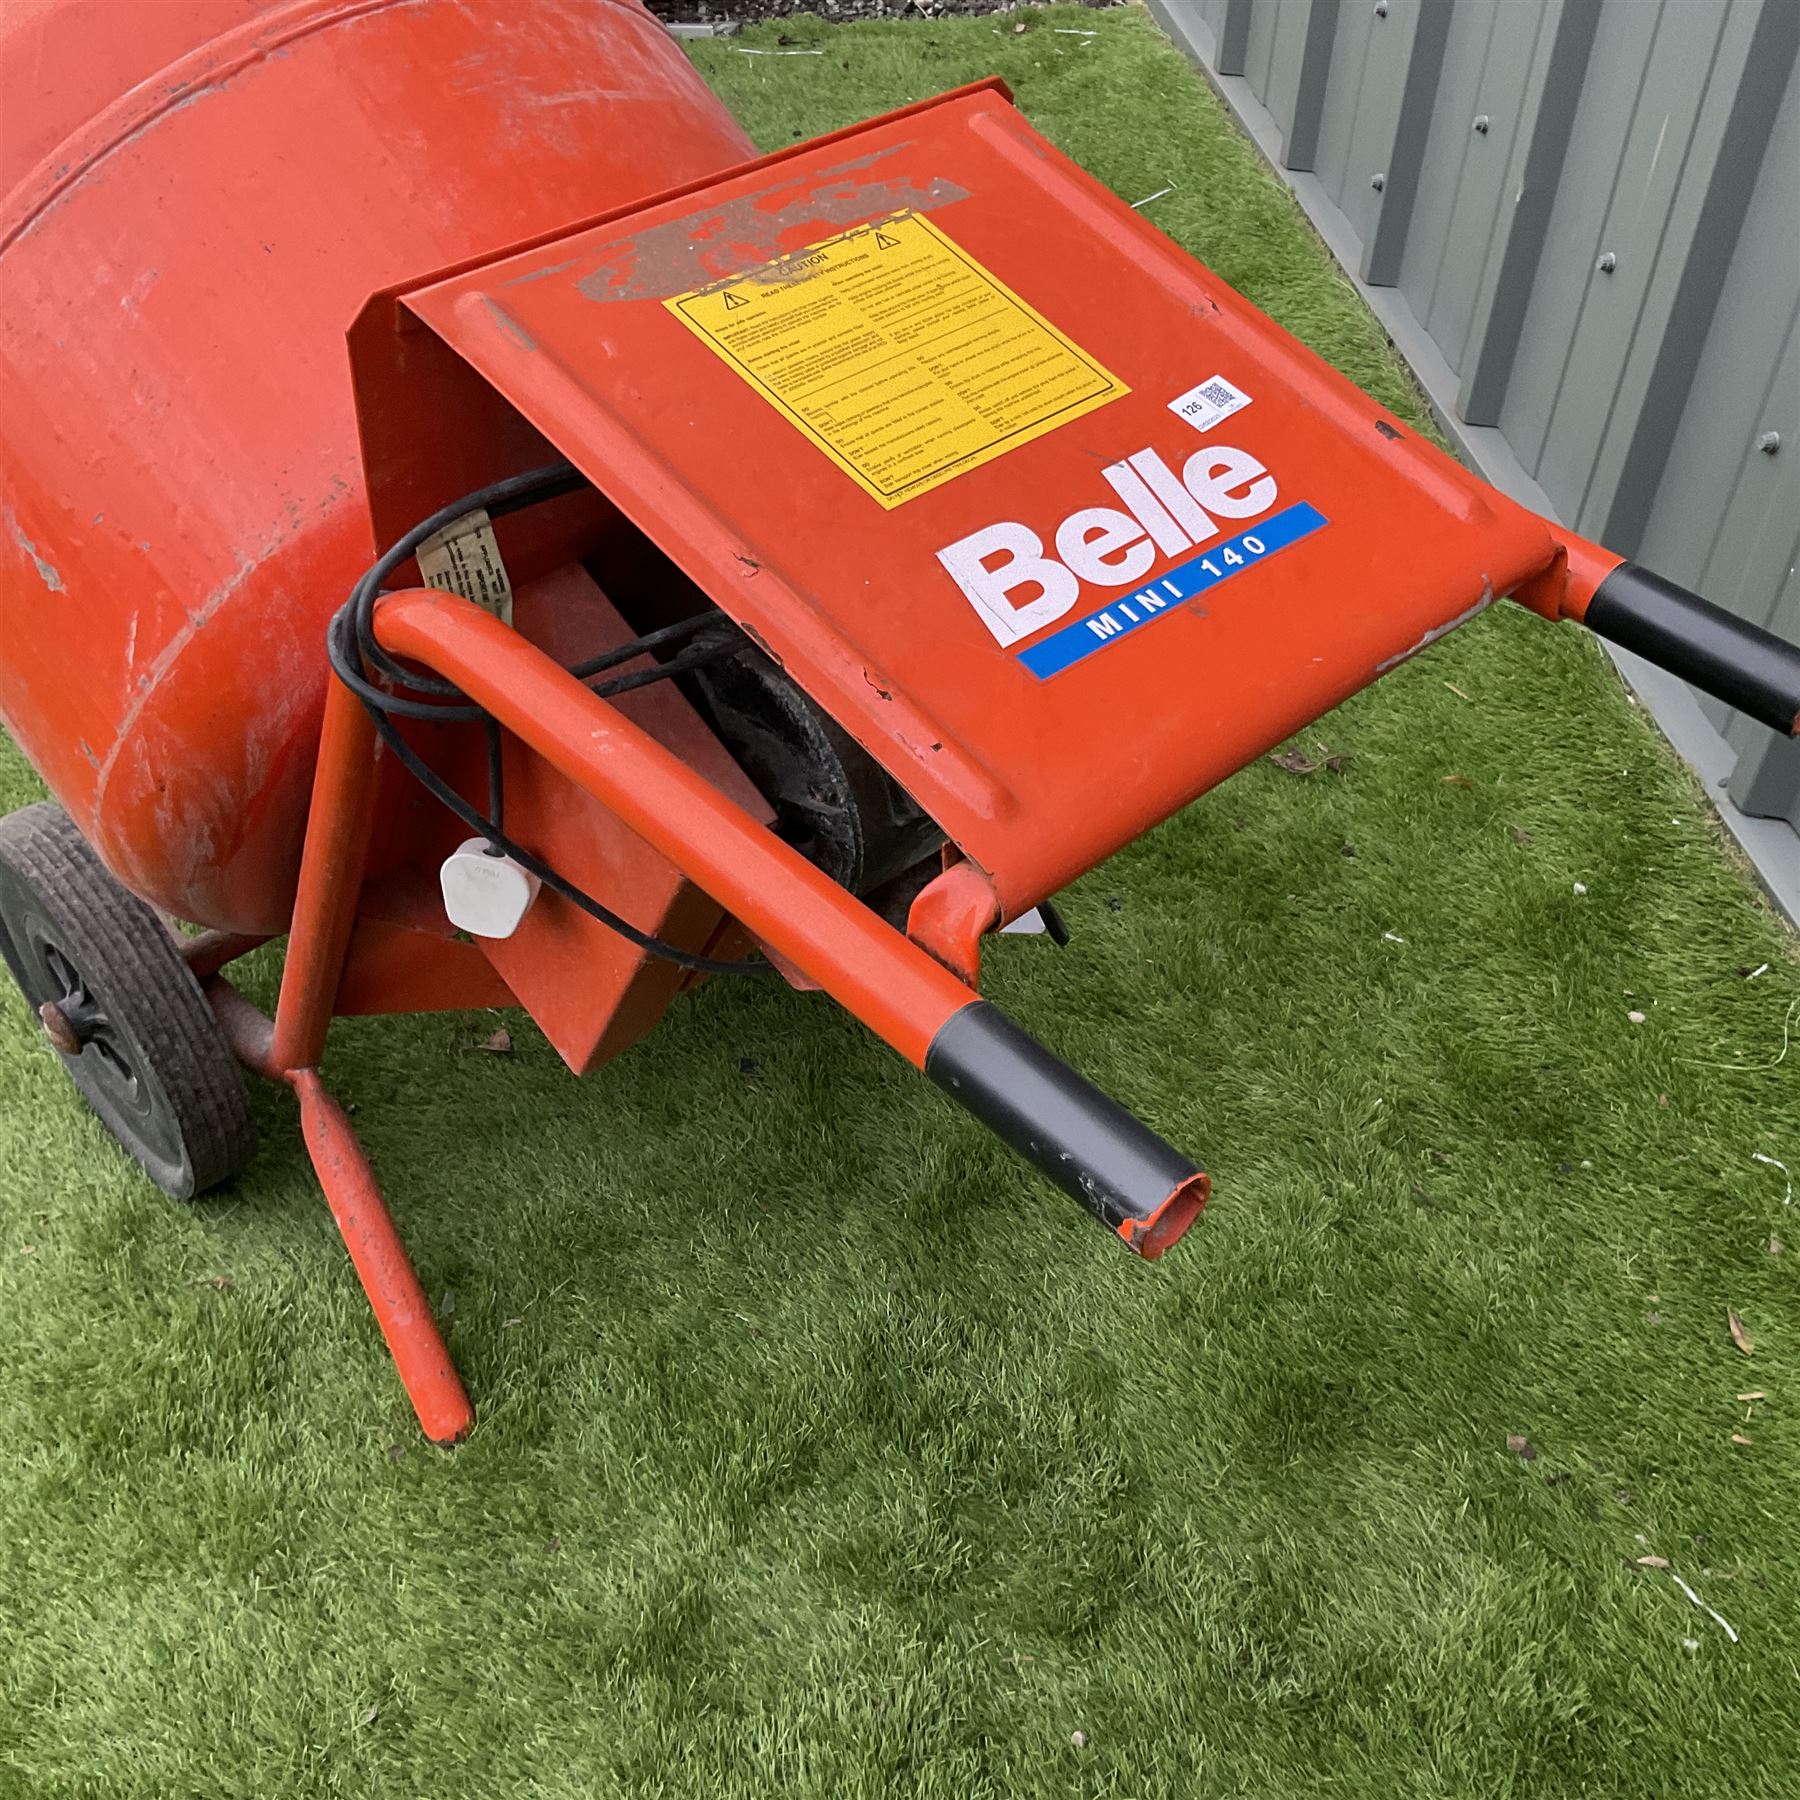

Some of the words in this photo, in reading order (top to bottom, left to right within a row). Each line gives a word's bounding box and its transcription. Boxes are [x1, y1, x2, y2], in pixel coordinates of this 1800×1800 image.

[759, 287, 781, 298] READ
[821, 252, 871, 274] INSTRUCTIONS
[777, 252, 830, 276] CAUTION
[1182, 402, 1202, 416] 126
[936, 446, 1278, 649] Belle
[1086, 580, 1183, 640] MINI
[1201, 536, 1266, 578] 140
